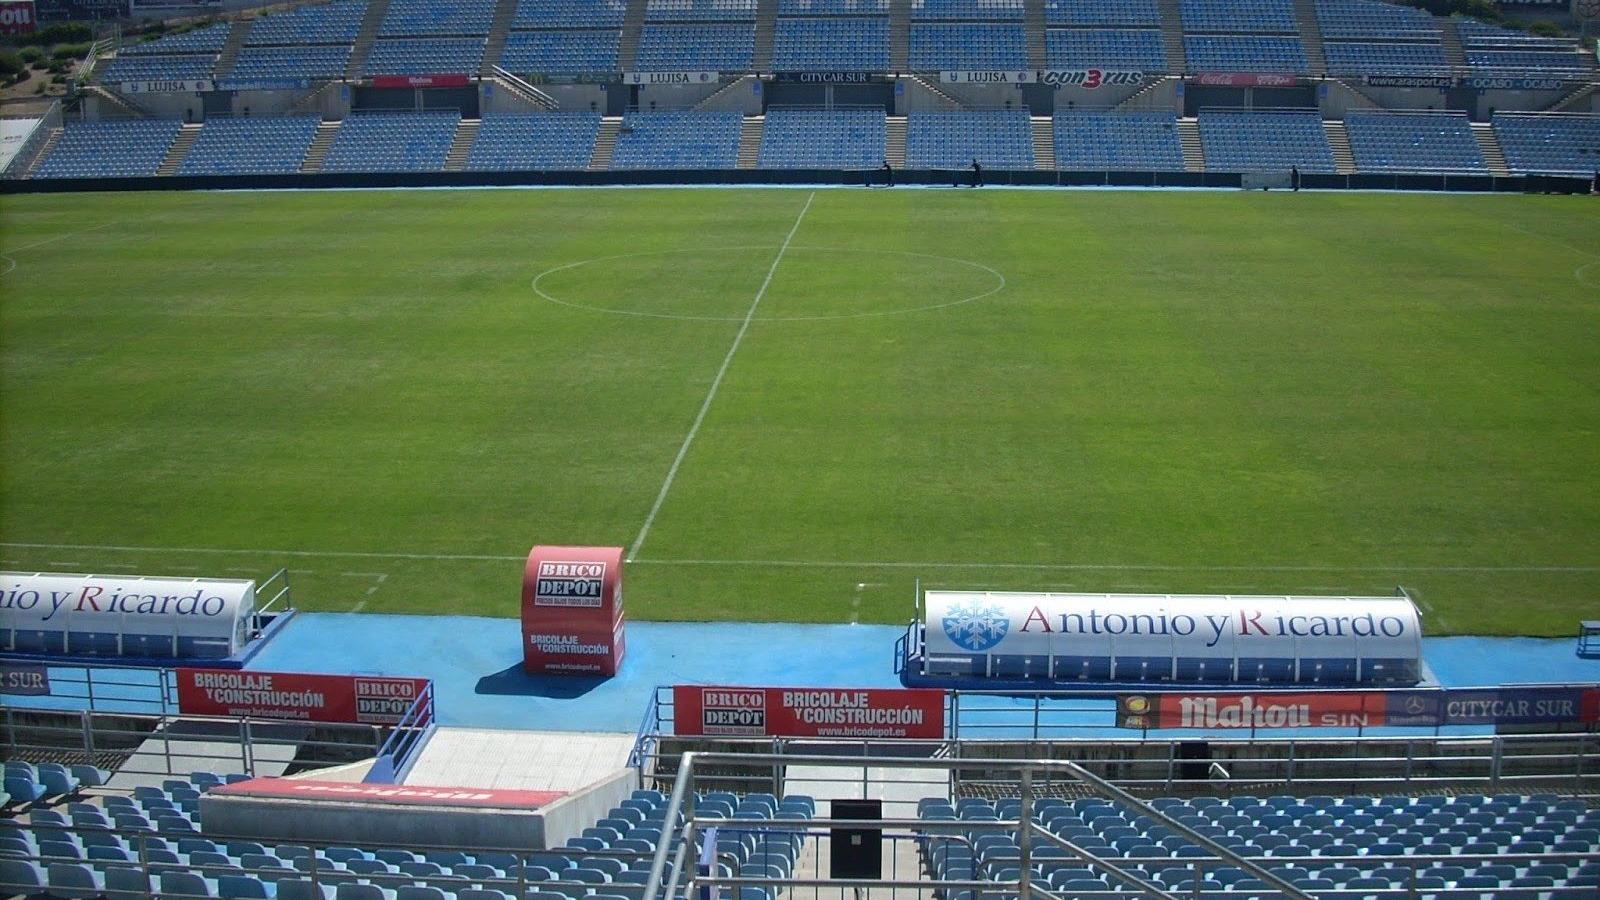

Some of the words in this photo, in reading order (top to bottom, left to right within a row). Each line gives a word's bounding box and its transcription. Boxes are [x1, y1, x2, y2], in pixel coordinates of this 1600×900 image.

[650, 73, 690, 83] LUJISA
[800, 72, 843, 82] CITYCAR
[845, 72, 867, 82] SUR
[967, 72, 1008, 82] LUJISA
[1473, 78, 1513, 88] OCASO
[1523, 79, 1563, 89] OCASO
[147, 82, 186, 92] LUJISA
[541, 563, 602, 577] BRICO
[0, 584, 39, 610] io
[42, 590, 72, 621] y
[73, 586, 225, 616] Ricardo
[1018, 604, 1196, 637] Antonio
[1204, 613, 1230, 648] y
[1237, 608, 1405, 638] Ricardo
[530, 634, 579, 645] BRICOLAJE
[542, 643, 609, 654] CONSTRUCCIÓN
[9, 672, 43, 688] SUR
[194, 672, 273, 690] BRICOLAJE
[357, 682, 413, 697] BRICO
[214, 689, 324, 708] CONSTRUCCIÓN
[704, 691, 763, 707] BRICO
[783, 691, 869, 708] BRICOLAJE
[803, 705, 922, 725] CONSTRUCCIÓN
[1178, 695, 1312, 728] Mahou
[1320, 713, 1369, 727] SIN
[1446, 700, 1530, 717] CITYCAR
[1535, 699, 1574, 716] SUR
[817, 726, 906, 738] www.bricodepot.es
